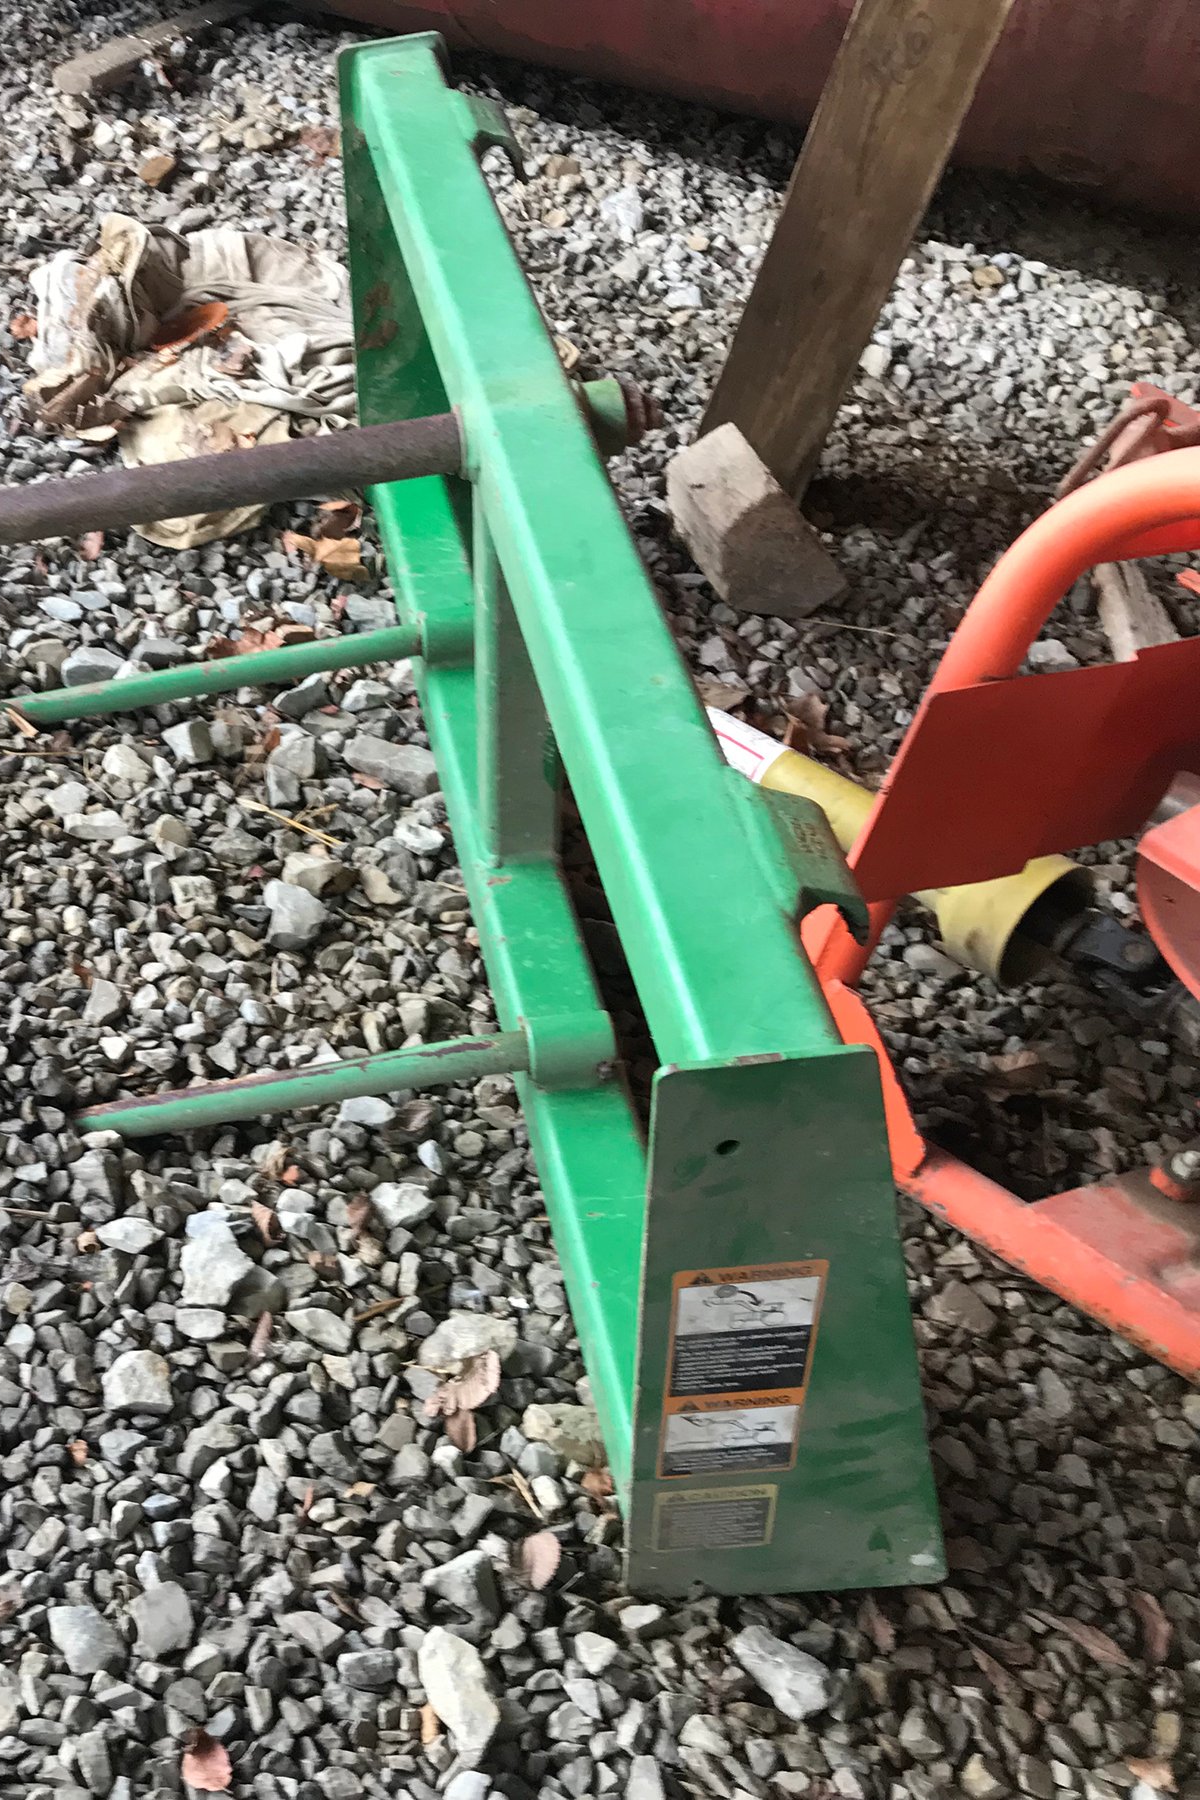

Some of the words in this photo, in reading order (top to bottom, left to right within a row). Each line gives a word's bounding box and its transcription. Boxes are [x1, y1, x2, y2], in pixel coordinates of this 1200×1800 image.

[718, 1266, 812, 1281] WARNING
[704, 1395, 791, 1408] WARNING
[688, 1488, 767, 1500] CAUTION
